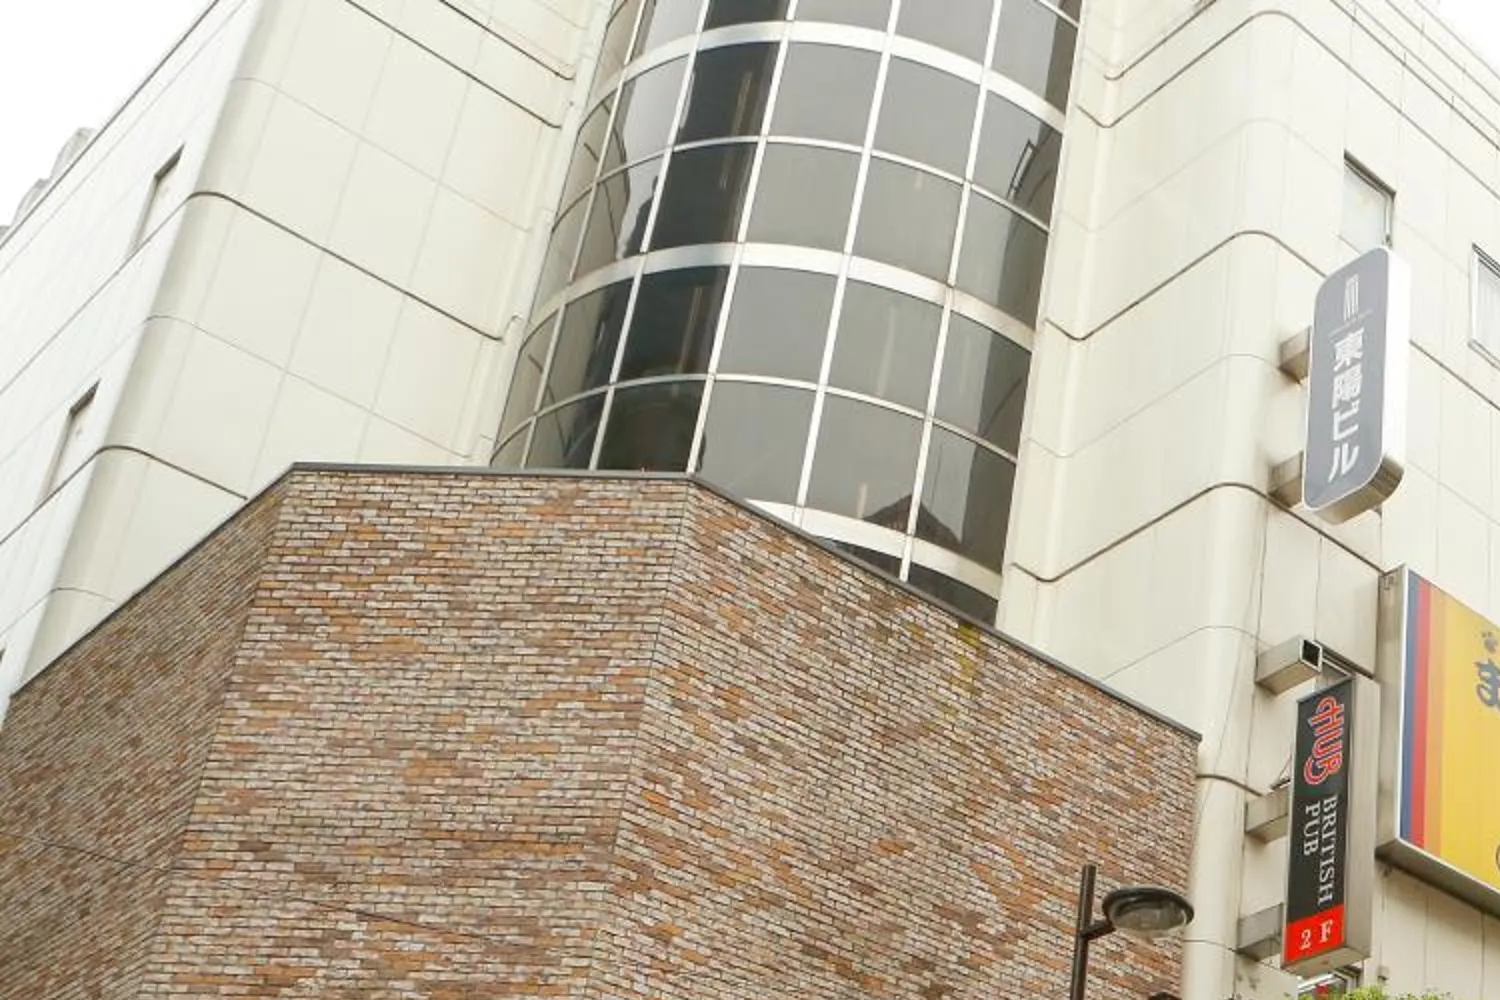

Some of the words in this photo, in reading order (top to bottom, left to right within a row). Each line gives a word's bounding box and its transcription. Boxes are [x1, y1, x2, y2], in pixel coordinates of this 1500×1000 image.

[1303, 695, 1345, 786] HUB
[1303, 800, 1321, 856] PUB
[1317, 794, 1338, 905] BRITISH
